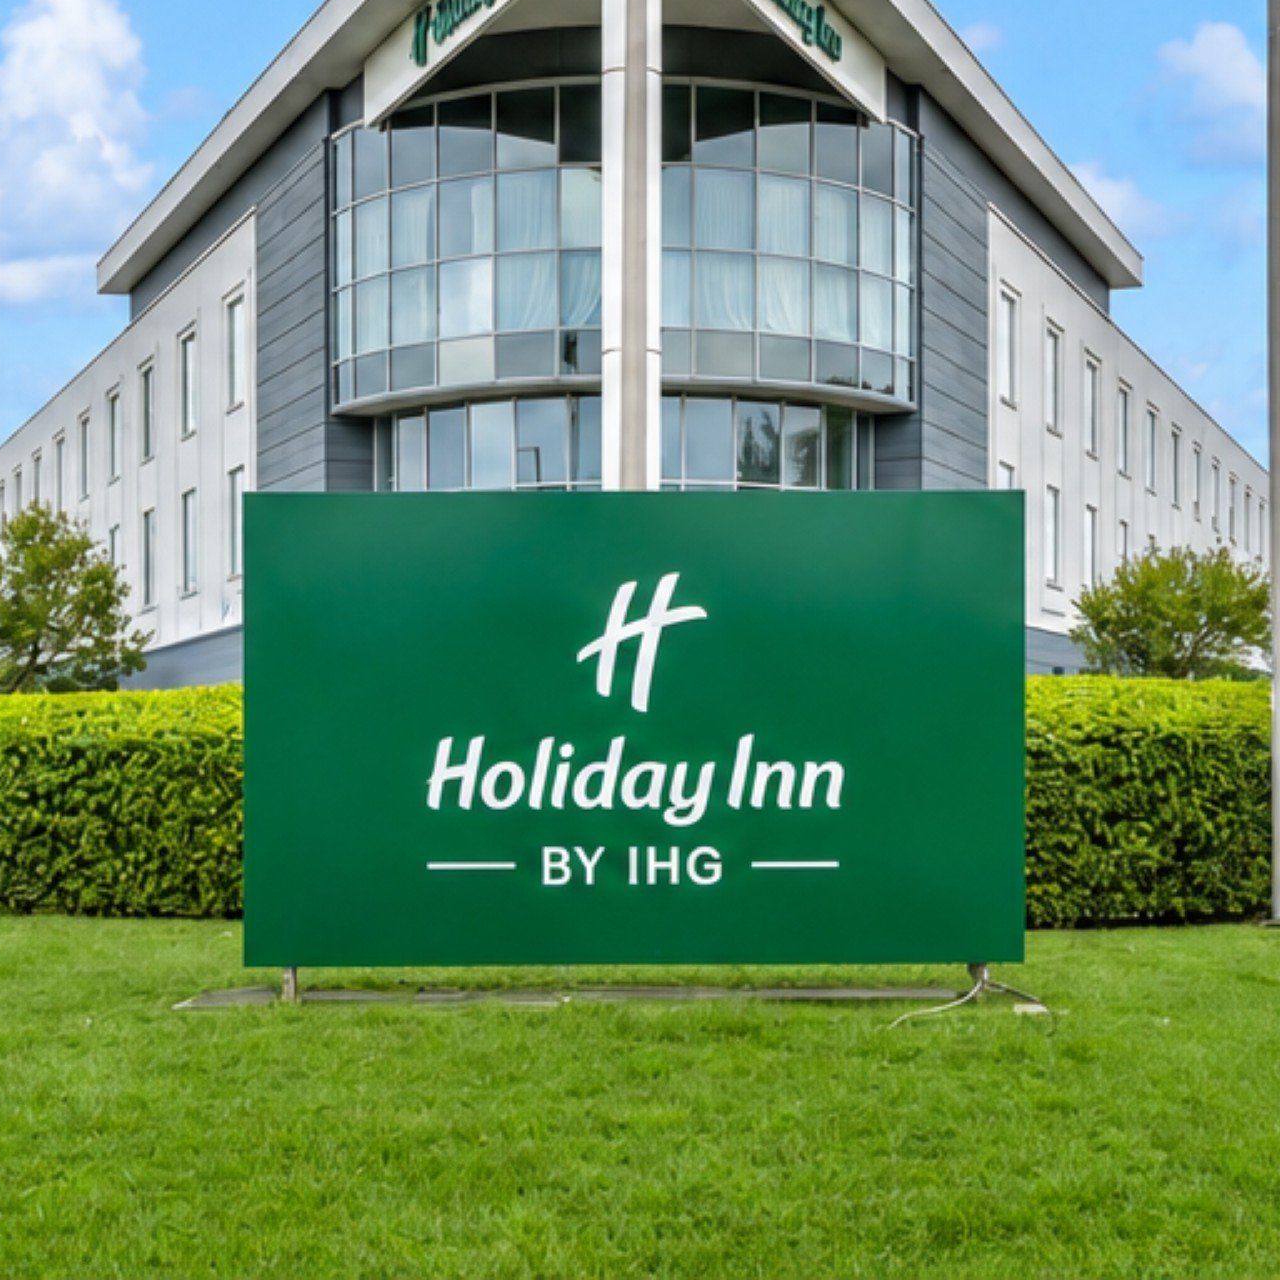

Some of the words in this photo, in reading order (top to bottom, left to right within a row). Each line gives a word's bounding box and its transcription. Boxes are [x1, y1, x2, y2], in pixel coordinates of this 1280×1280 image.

[577, 572, 708, 713] H
[426, 734, 716, 827] Holiday
[727, 733, 845, 811] Inn
[542, 846, 605, 886] BY
[629, 846, 723, 886] IHG
